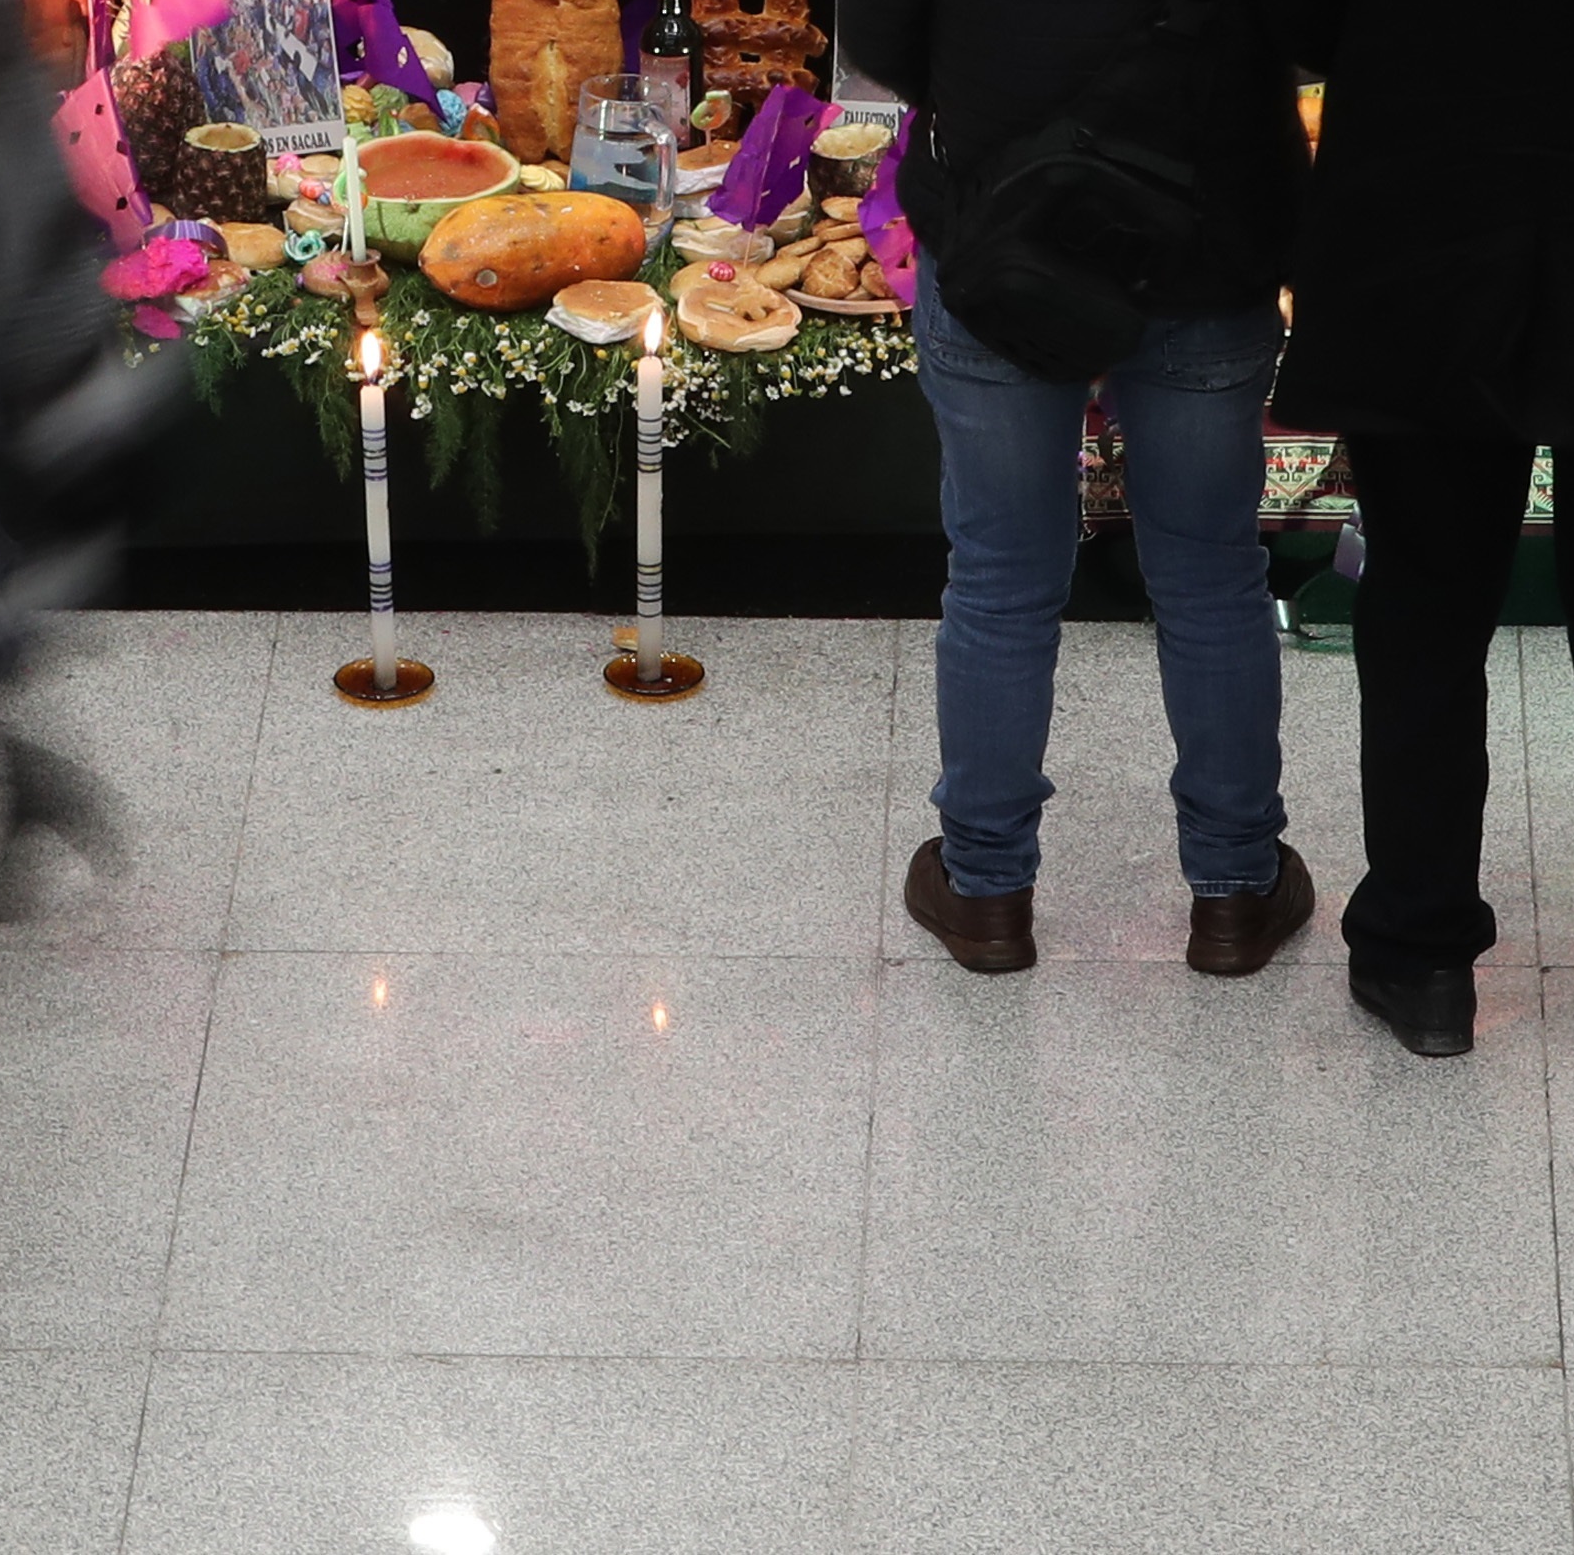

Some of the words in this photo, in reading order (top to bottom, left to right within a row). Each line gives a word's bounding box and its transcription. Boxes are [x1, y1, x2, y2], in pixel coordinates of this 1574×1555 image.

[845, 111, 897, 130] FALLECIDOS
[276, 136, 290, 153] EN
[291, 131, 332, 151] SACABA
